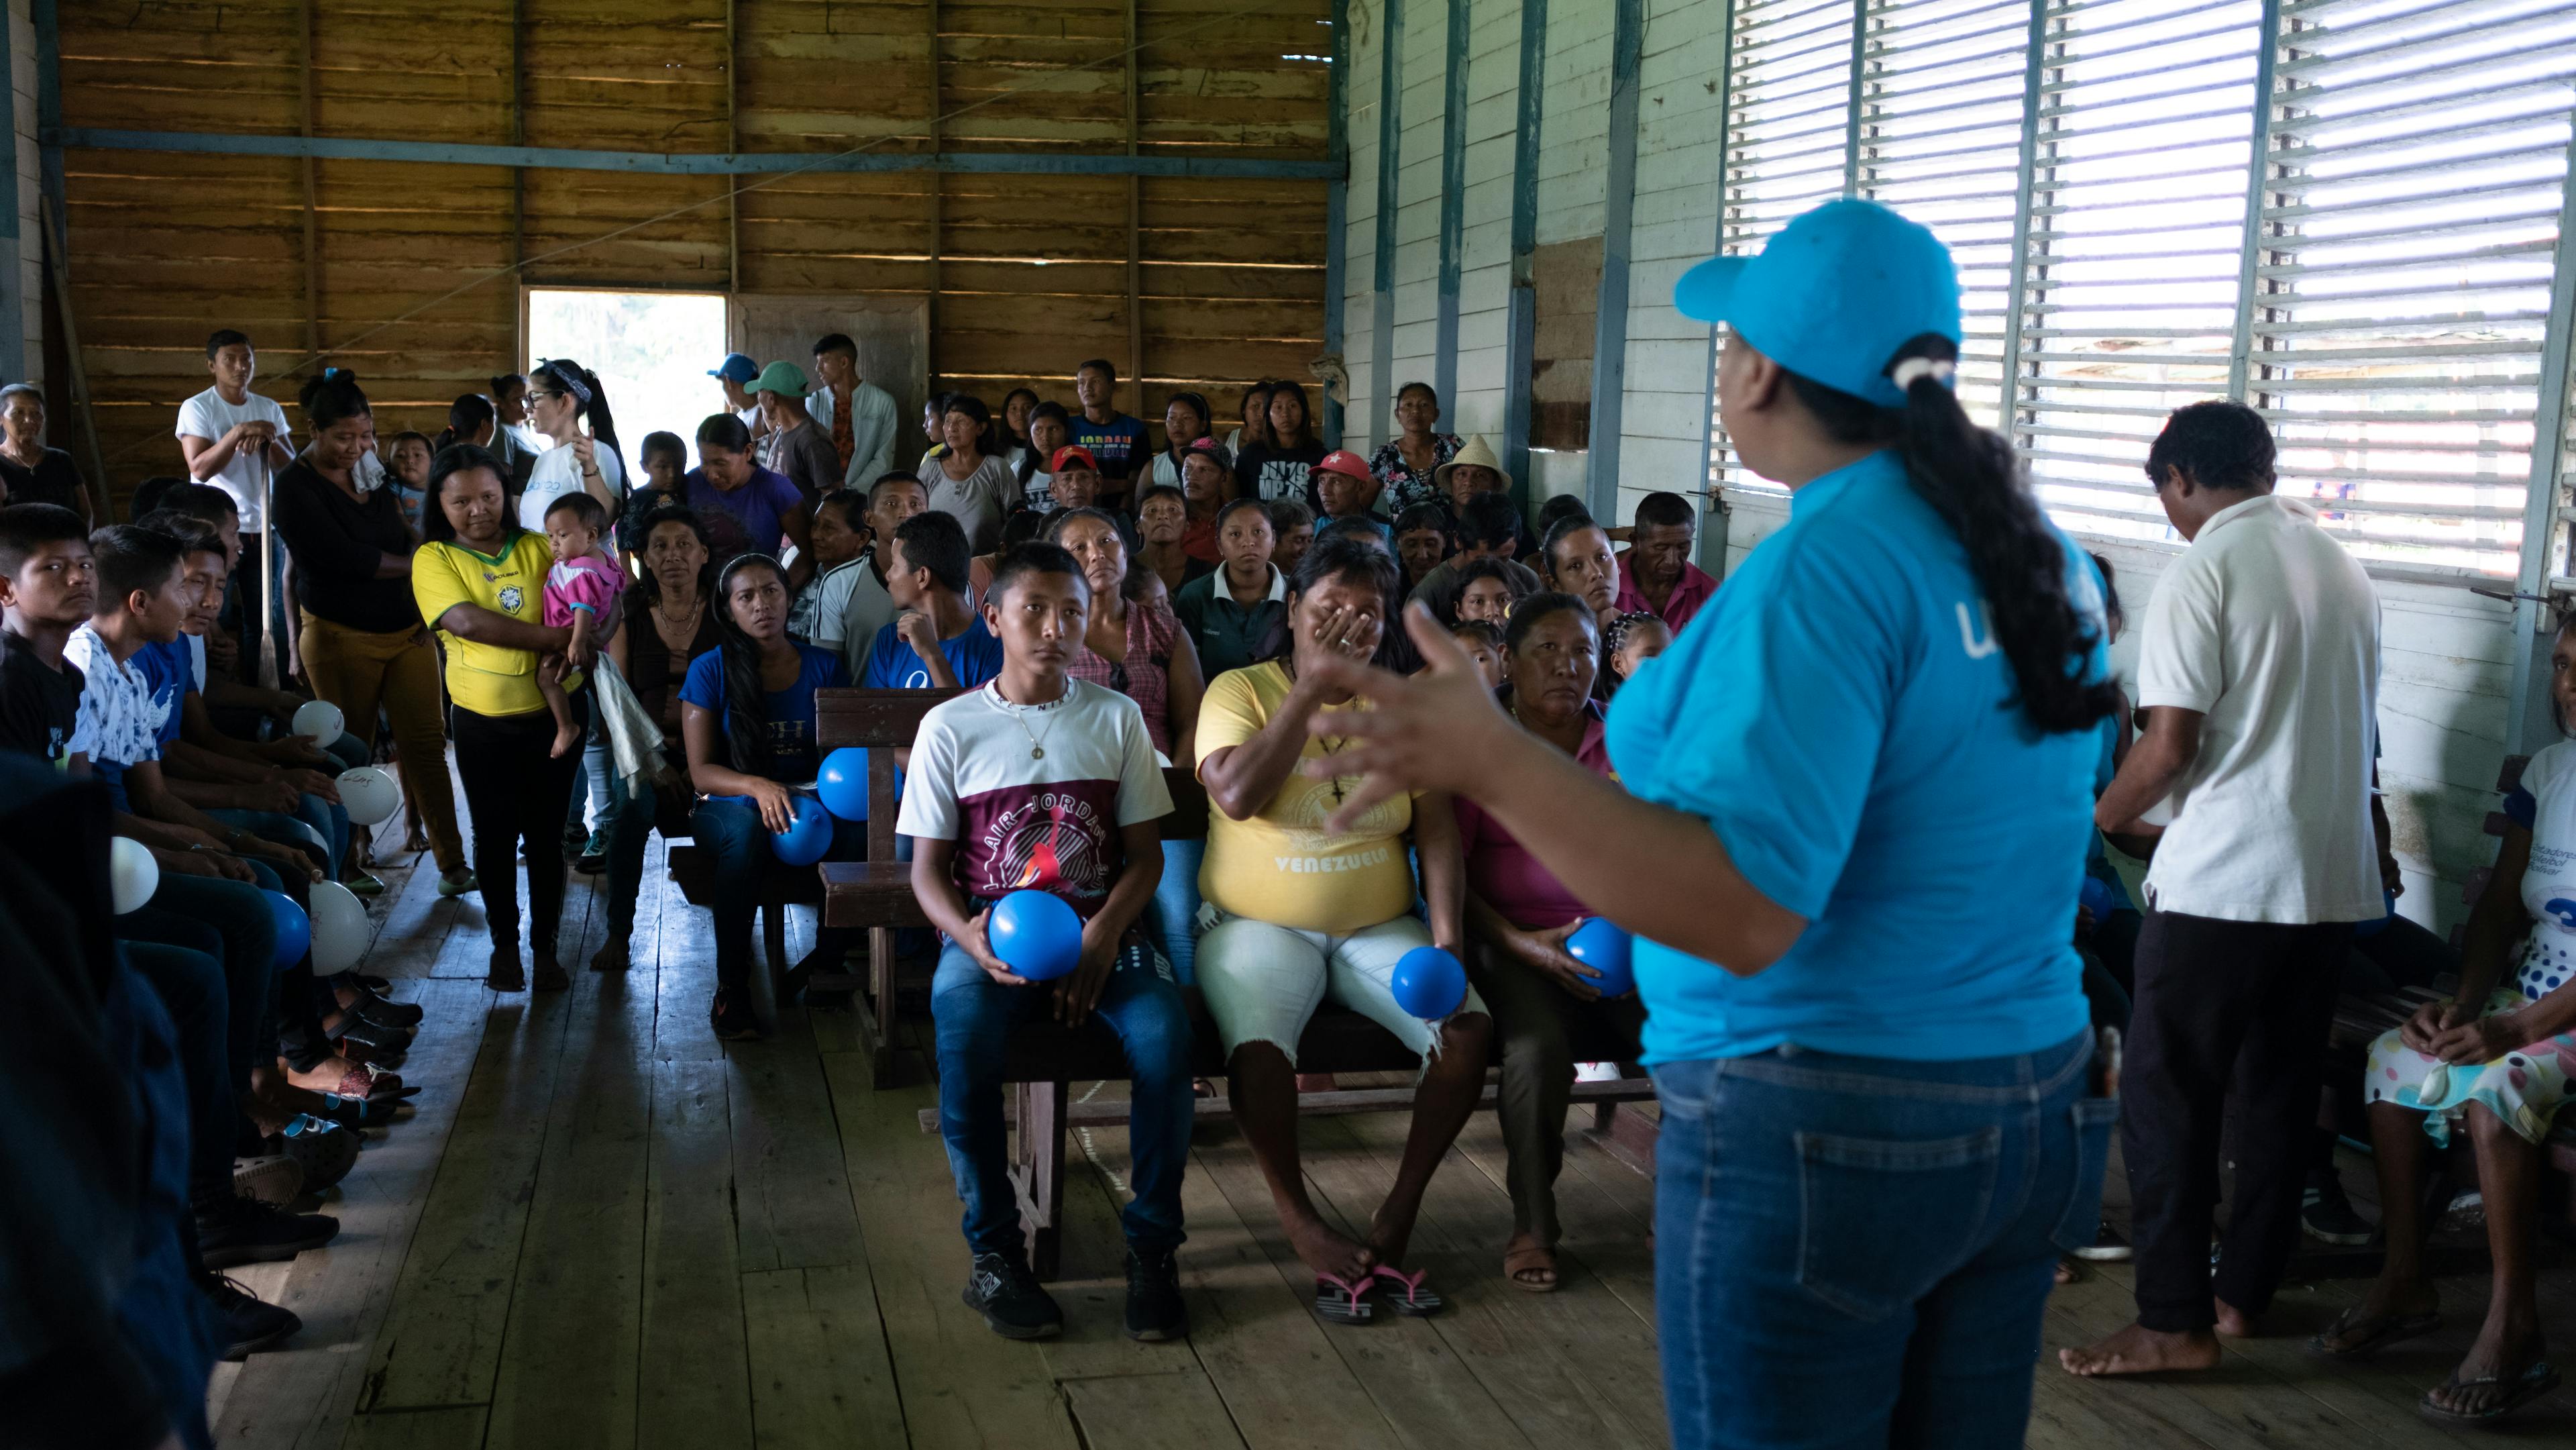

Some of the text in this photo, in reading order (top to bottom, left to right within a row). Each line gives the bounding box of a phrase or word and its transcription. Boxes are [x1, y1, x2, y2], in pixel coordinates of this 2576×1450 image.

[983, 792, 1106, 852] AIR JORDAN
[1275, 847, 1389, 873] VENEZUELA
